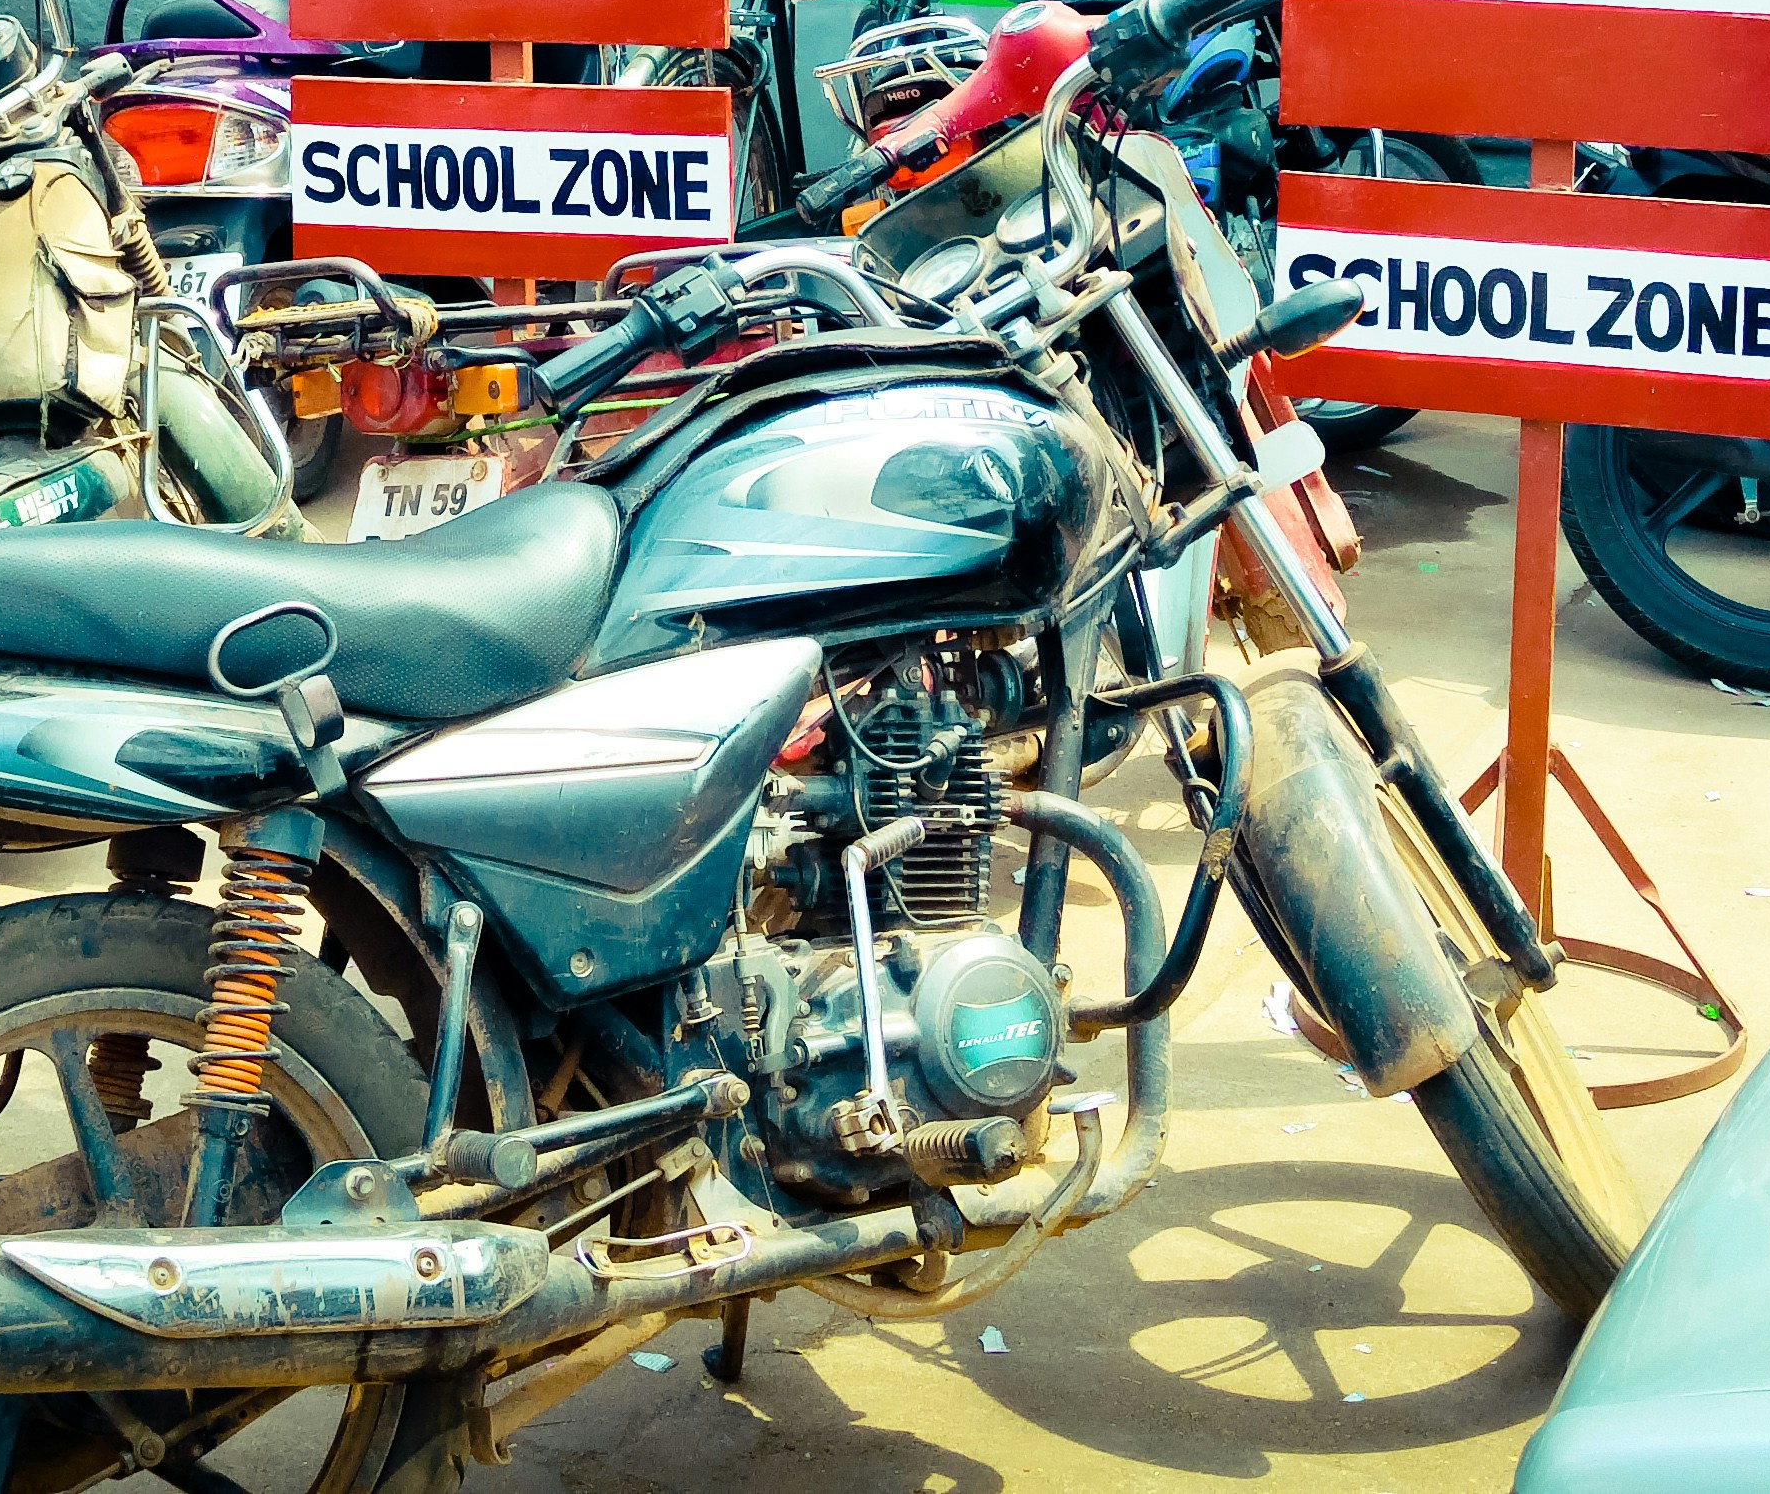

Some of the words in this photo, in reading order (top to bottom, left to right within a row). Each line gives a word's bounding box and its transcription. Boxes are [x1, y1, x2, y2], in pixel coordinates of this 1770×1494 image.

[301, 140, 541, 215] SCHOOL
[549, 147, 712, 222] ZONE
[14, 473, 77, 522] HEAVY
[37, 491, 80, 524] DUTY
[383, 484, 422, 517] TN
[430, 482, 468, 516] 59
